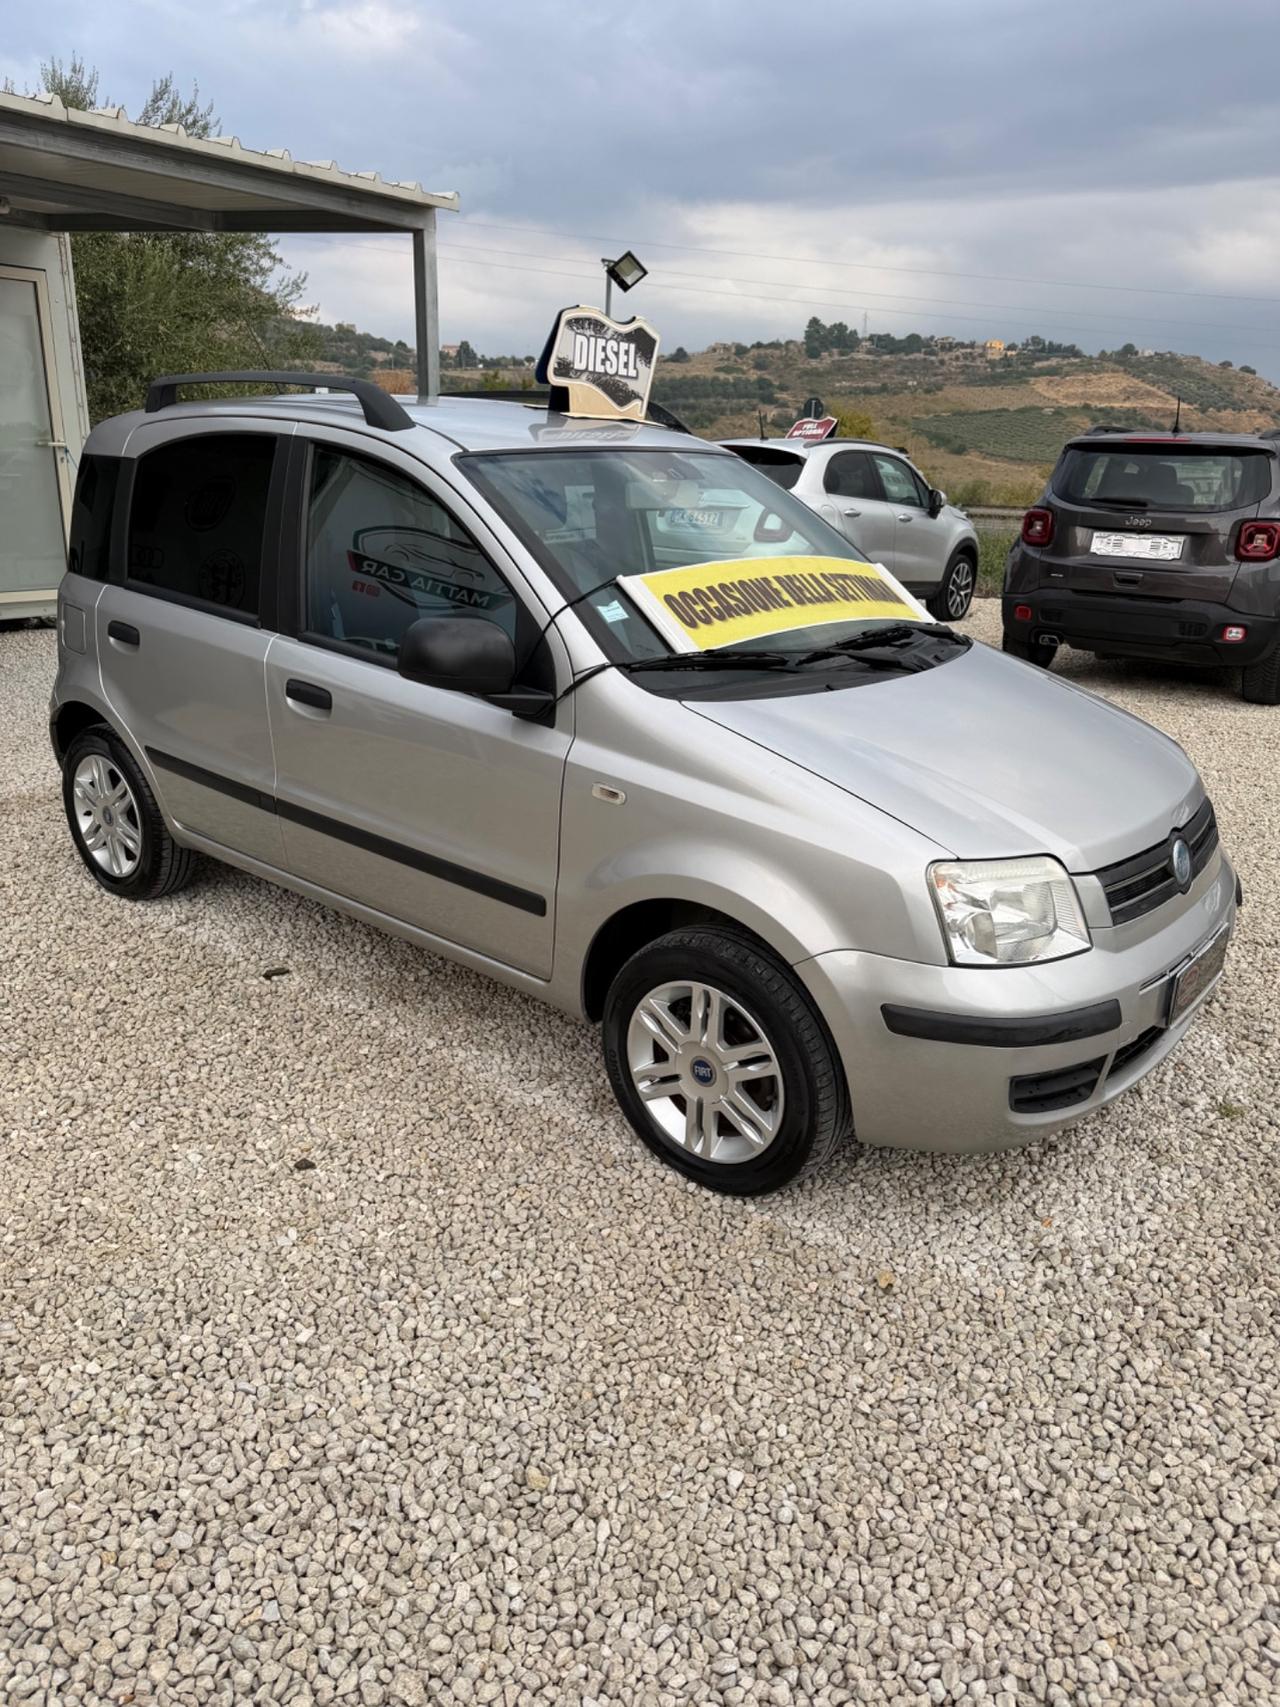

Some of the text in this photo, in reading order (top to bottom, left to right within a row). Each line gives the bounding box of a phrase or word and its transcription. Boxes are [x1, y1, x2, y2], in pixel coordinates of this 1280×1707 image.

[574, 334, 637, 377] DIESEL
[1125, 516, 1152, 528] Jeep
[664, 577, 793, 629] OCCASIONE
[772, 572, 842, 606] DELLA
[694, 1065, 711, 1077] FIAT
